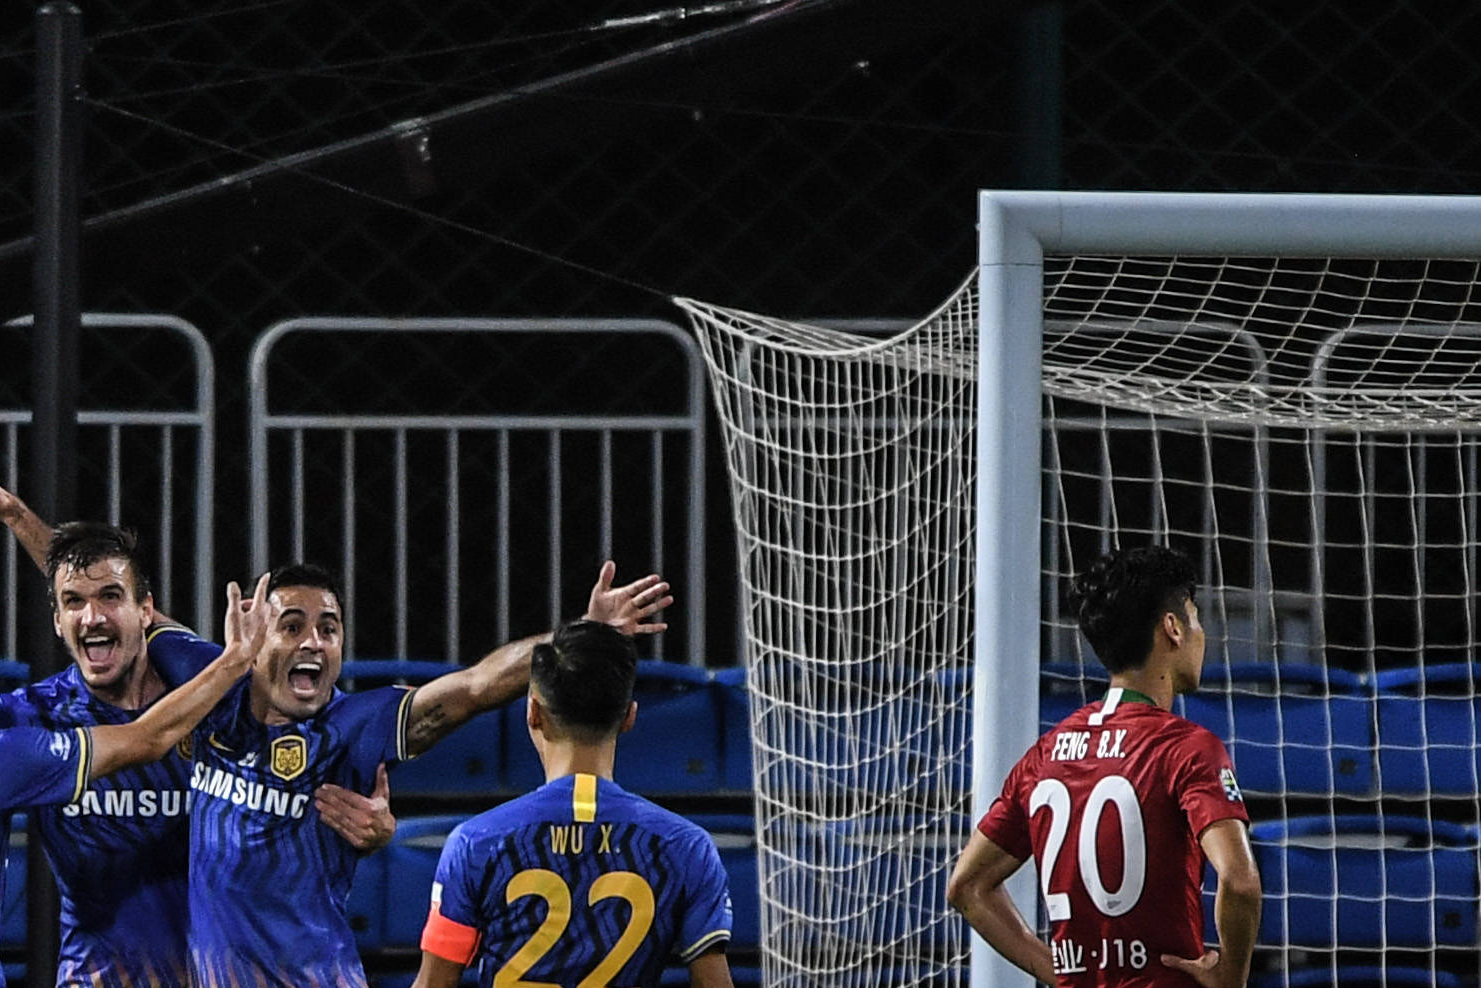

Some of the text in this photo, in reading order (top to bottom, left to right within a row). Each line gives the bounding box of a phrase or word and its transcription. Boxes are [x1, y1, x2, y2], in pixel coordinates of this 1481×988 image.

[1051, 731, 1090, 762] FENG
[63, 790, 191, 817] SAMSU
[191, 761, 310, 819] SAMSUNG
[550, 824, 621, 855] WU X.
[1029, 775, 1147, 921] 20
